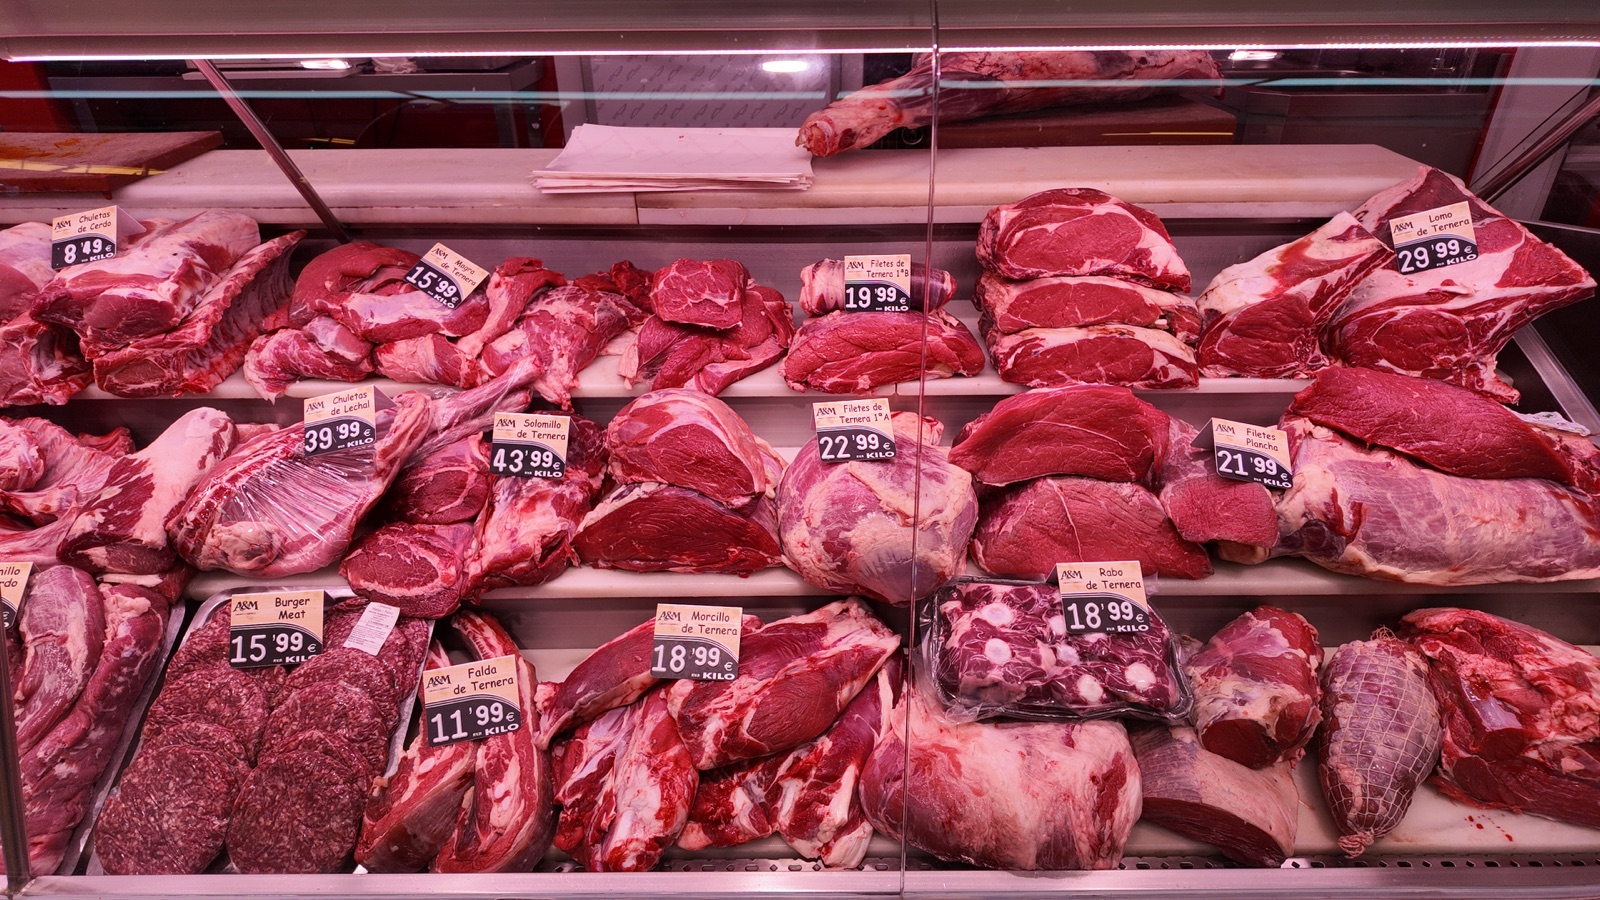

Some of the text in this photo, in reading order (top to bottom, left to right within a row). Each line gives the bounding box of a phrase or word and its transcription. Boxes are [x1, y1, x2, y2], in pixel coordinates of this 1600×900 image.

[79, 212, 110, 223] Chuletas
[1429, 212, 1452, 222] Lomo
[90, 220, 112, 230] Cerdo
[1417, 228, 1428, 236] de
[1432, 219, 1469, 232] Ternera
[90, 252, 114, 261] KILO
[1446, 254, 1476, 265] KILO
[455, 260, 475, 274] Magra
[453, 267, 476, 286] Ternera
[434, 294, 455, 308] KILO
[333, 392, 367, 404] Chuletas
[344, 400, 370, 413] Lechal
[844, 404, 869, 412] Filetes
[524, 420, 561, 428] Solomillo
[517, 430, 566, 440] de Ternera
[1246, 428, 1276, 440] Filetes
[348, 438, 374, 447] KILO
[1246, 438, 1278, 451] Plancha
[1264, 478, 1292, 488] KILO
[1100, 568, 1123, 576] Rabo
[1086, 581, 1098, 590] de
[275, 598, 310, 608] Burger
[278, 610, 306, 620] Meat
[692, 611, 730, 622] Morcillo
[682, 624, 737, 635] de Ternera
[468, 665, 496, 678] Falda
[454, 684, 466, 694] de
[471, 678, 514, 690] Ternera
[485, 724, 519, 736] KILO
